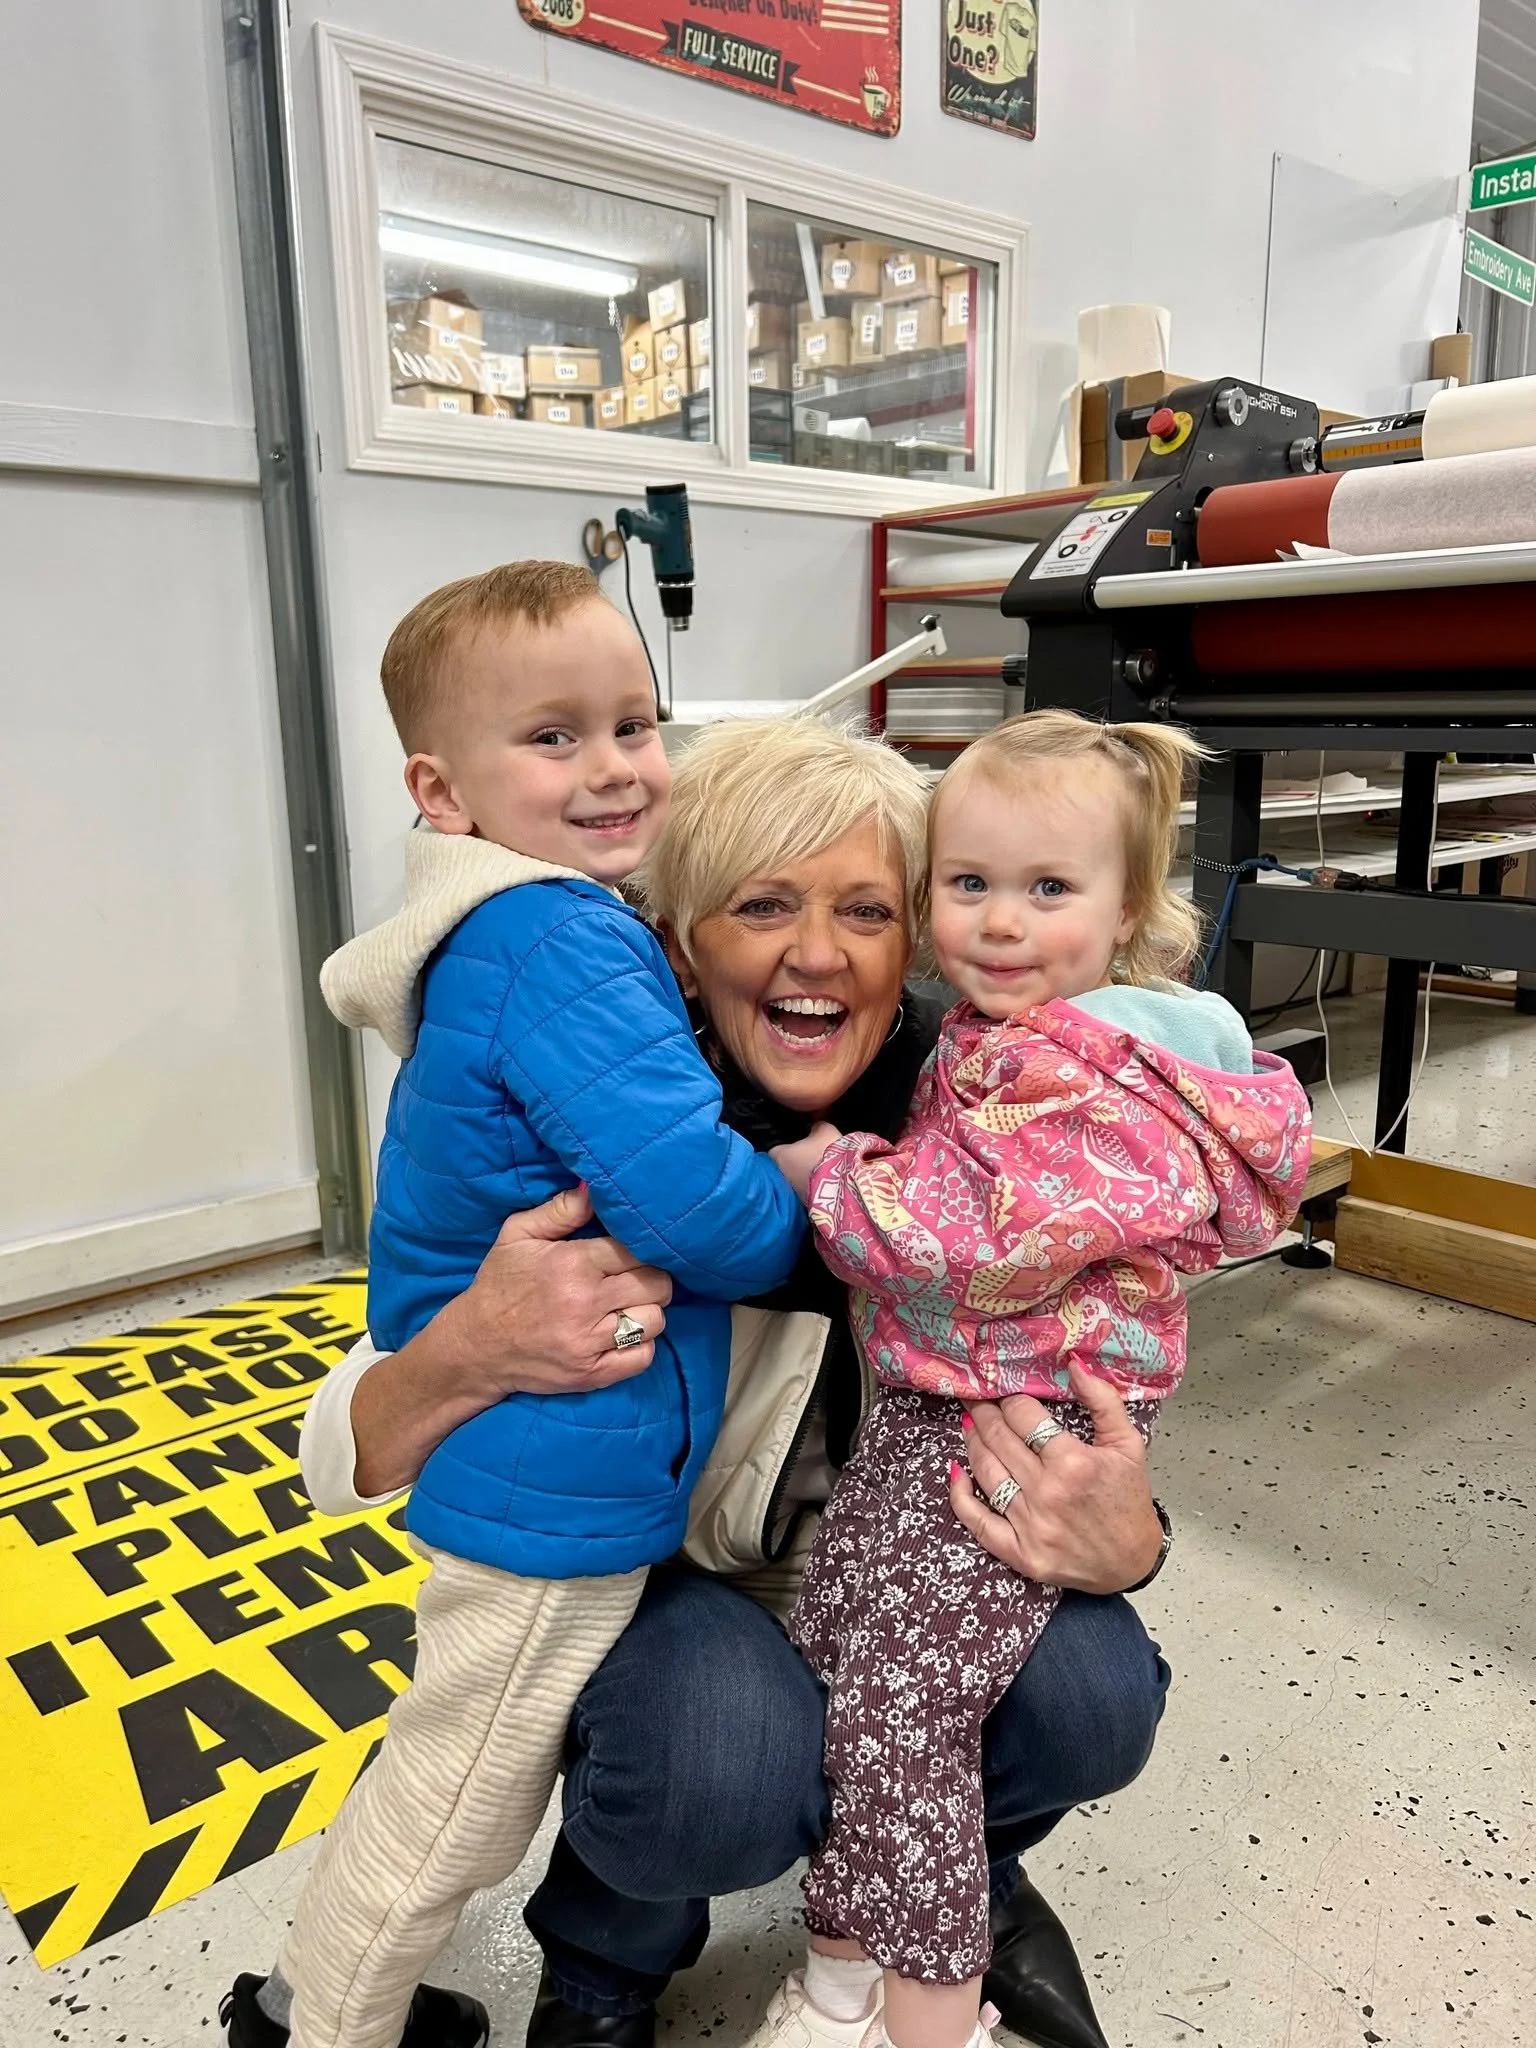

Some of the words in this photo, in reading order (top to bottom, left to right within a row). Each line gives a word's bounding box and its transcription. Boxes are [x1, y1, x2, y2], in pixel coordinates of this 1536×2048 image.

[953, 0, 995, 34] Just
[683, 27, 717, 61] FULL
[721, 39, 779, 80] SERVICE
[949, 35, 998, 72] One?
[1467, 240, 1514, 289] Embroidery
[1515, 266, 1532, 293] Ave
[1259, 391, 1282, 405] MODEL
[0, 1306, 353, 1421] LEASE
